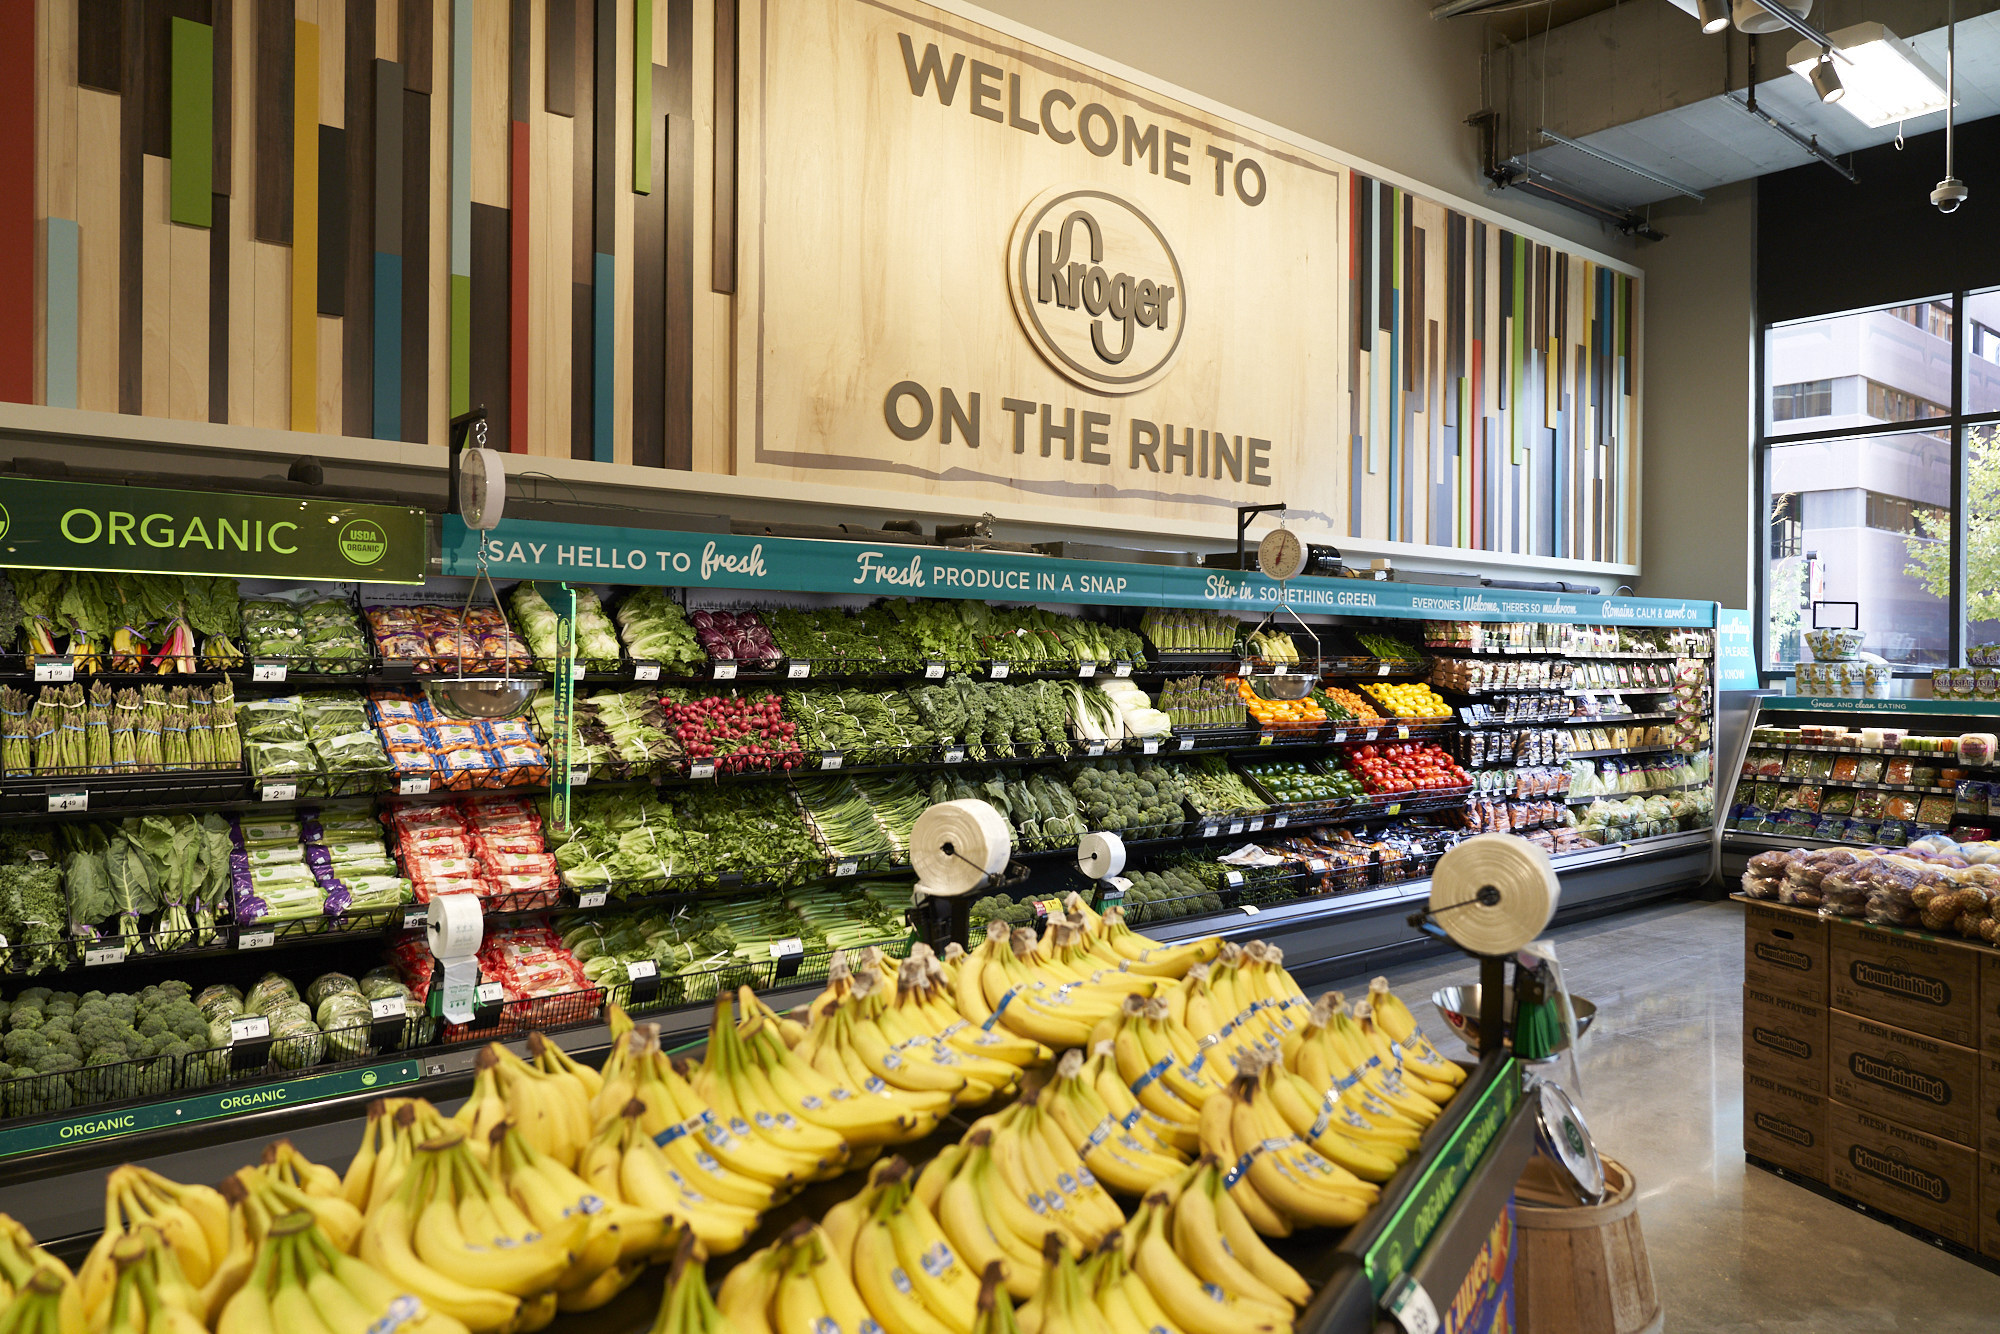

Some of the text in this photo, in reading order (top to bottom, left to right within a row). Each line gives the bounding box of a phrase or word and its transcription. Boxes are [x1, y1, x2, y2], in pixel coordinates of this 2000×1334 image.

[898, 32, 1267, 206] WELCOME TO
[1038, 210, 1175, 364] Kroger
[884, 380, 1272, 486] ON THE RHINE
[60, 508, 298, 555] ORGANIC
[350, 530, 376, 541] USDA
[347, 544, 379, 552] ORGANIC
[488, 541, 767, 581] SAY HELLO TO fresh
[853, 552, 1127, 594] Fresh PRODUCE IN A SNAP
[1204, 574, 1376, 607] Stir in SOMETHING GREEN
[1412, 594, 1577, 614] EVERYONE'S Welcome, THERE'S SO mushroom
[1602, 600, 1697, 619] Romaine CALM & carrot ON
[1725, 647, 1749, 657] PLEASE
[558, 655, 567, 722] certified
[1725, 669, 1744, 680] KNOW
[1811, 699, 1835, 708] Green
[1855, 700, 1875, 709] clean
[556, 726, 565, 785] organic
[1859, 929, 1938, 954] FRESH POTATOES
[1750, 990, 1817, 1017] FRESH POTATOES
[1858, 1022, 1939, 1053] FRESH POTATOES
[220, 1088, 287, 1110] ORGANIC
[1750, 1075, 1819, 1106] FRESH POTATOES
[60, 1115, 135, 1139] ORGANIC
[1858, 1114, 1938, 1150] FRESH POTATOES
